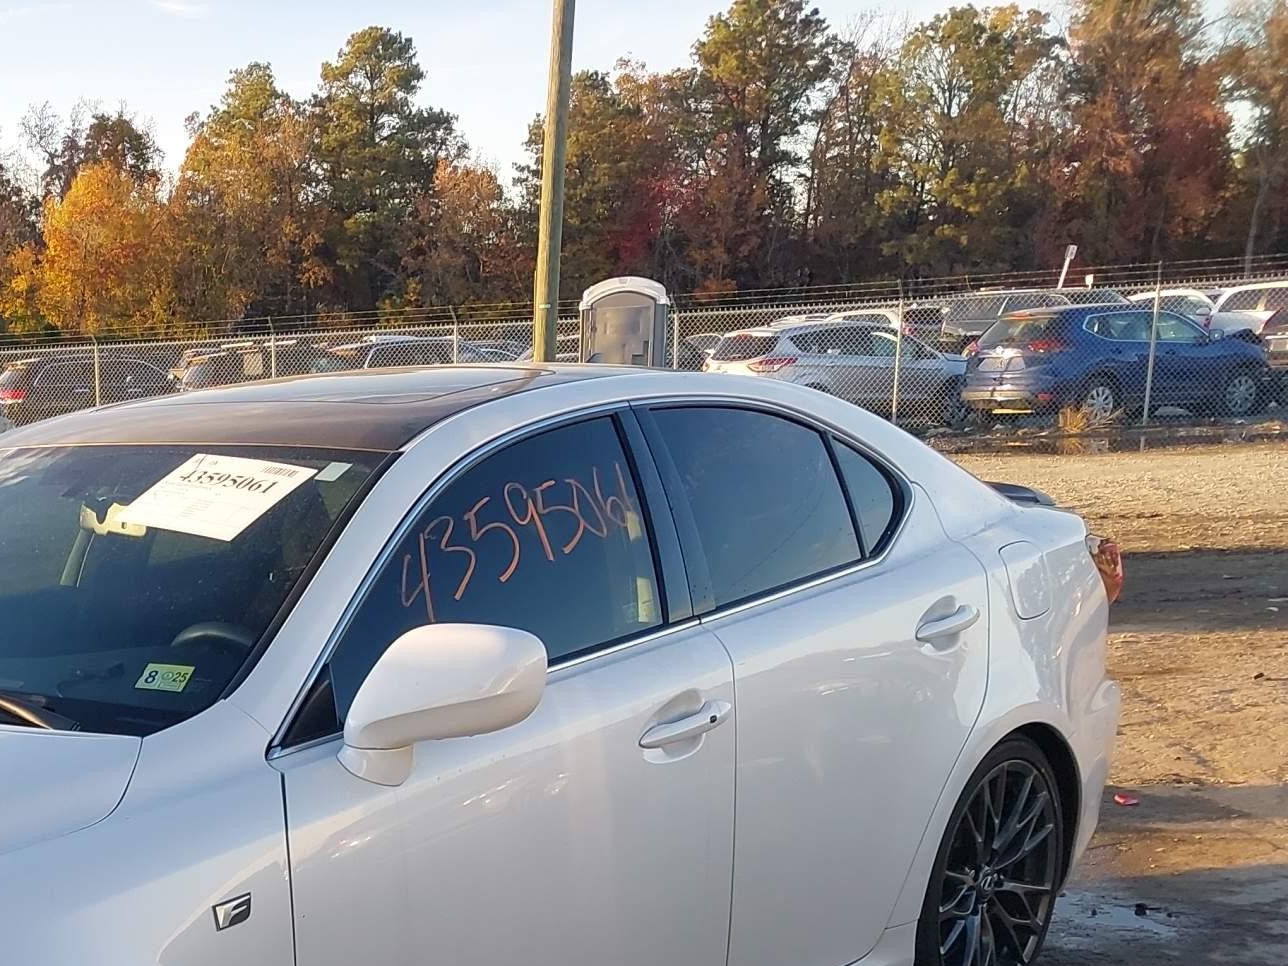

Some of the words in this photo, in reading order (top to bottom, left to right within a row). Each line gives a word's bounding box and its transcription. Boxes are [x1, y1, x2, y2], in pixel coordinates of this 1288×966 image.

[179, 470, 279, 494] 43595061
[402, 463, 633, 622] 43595061
[144, 670, 159, 684] 8
[172, 671, 189, 683] 25
